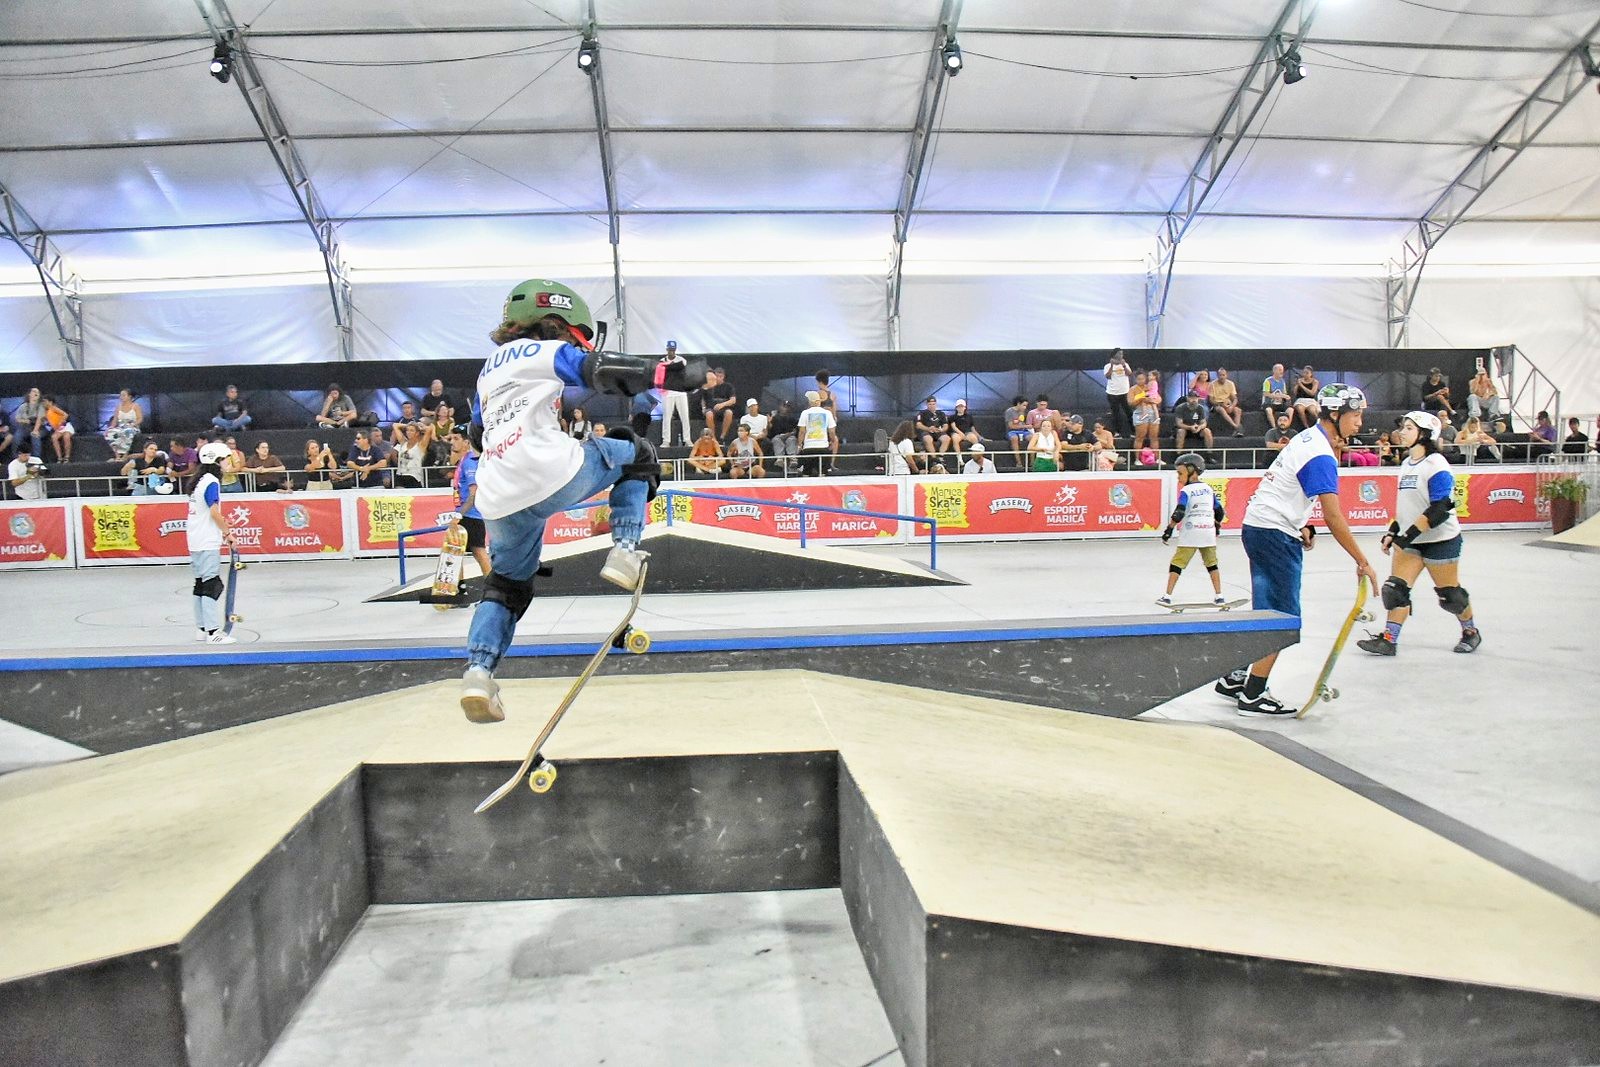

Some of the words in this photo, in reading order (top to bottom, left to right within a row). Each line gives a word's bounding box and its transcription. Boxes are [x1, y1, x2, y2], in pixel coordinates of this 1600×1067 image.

[929, 496, 962, 509] Skate
[653, 501, 687, 516] Skte
[1043, 505, 1088, 515] ESPORTE
[372, 510, 406, 523] Skate
[774, 512, 820, 522] ESPOTE
[1098, 513, 1142, 524] MARICÁ
[1348, 509, 1388, 520] MARICÁ
[97, 518, 130, 531] Skate
[165, 521, 187, 530] FASE
[776, 520, 818, 531] MARCÁ
[831, 520, 878, 532] MARICÁ
[229, 527, 263, 537] PORTE
[553, 527, 592, 538] MARIC
[274, 535, 322, 546] MARICÁ
